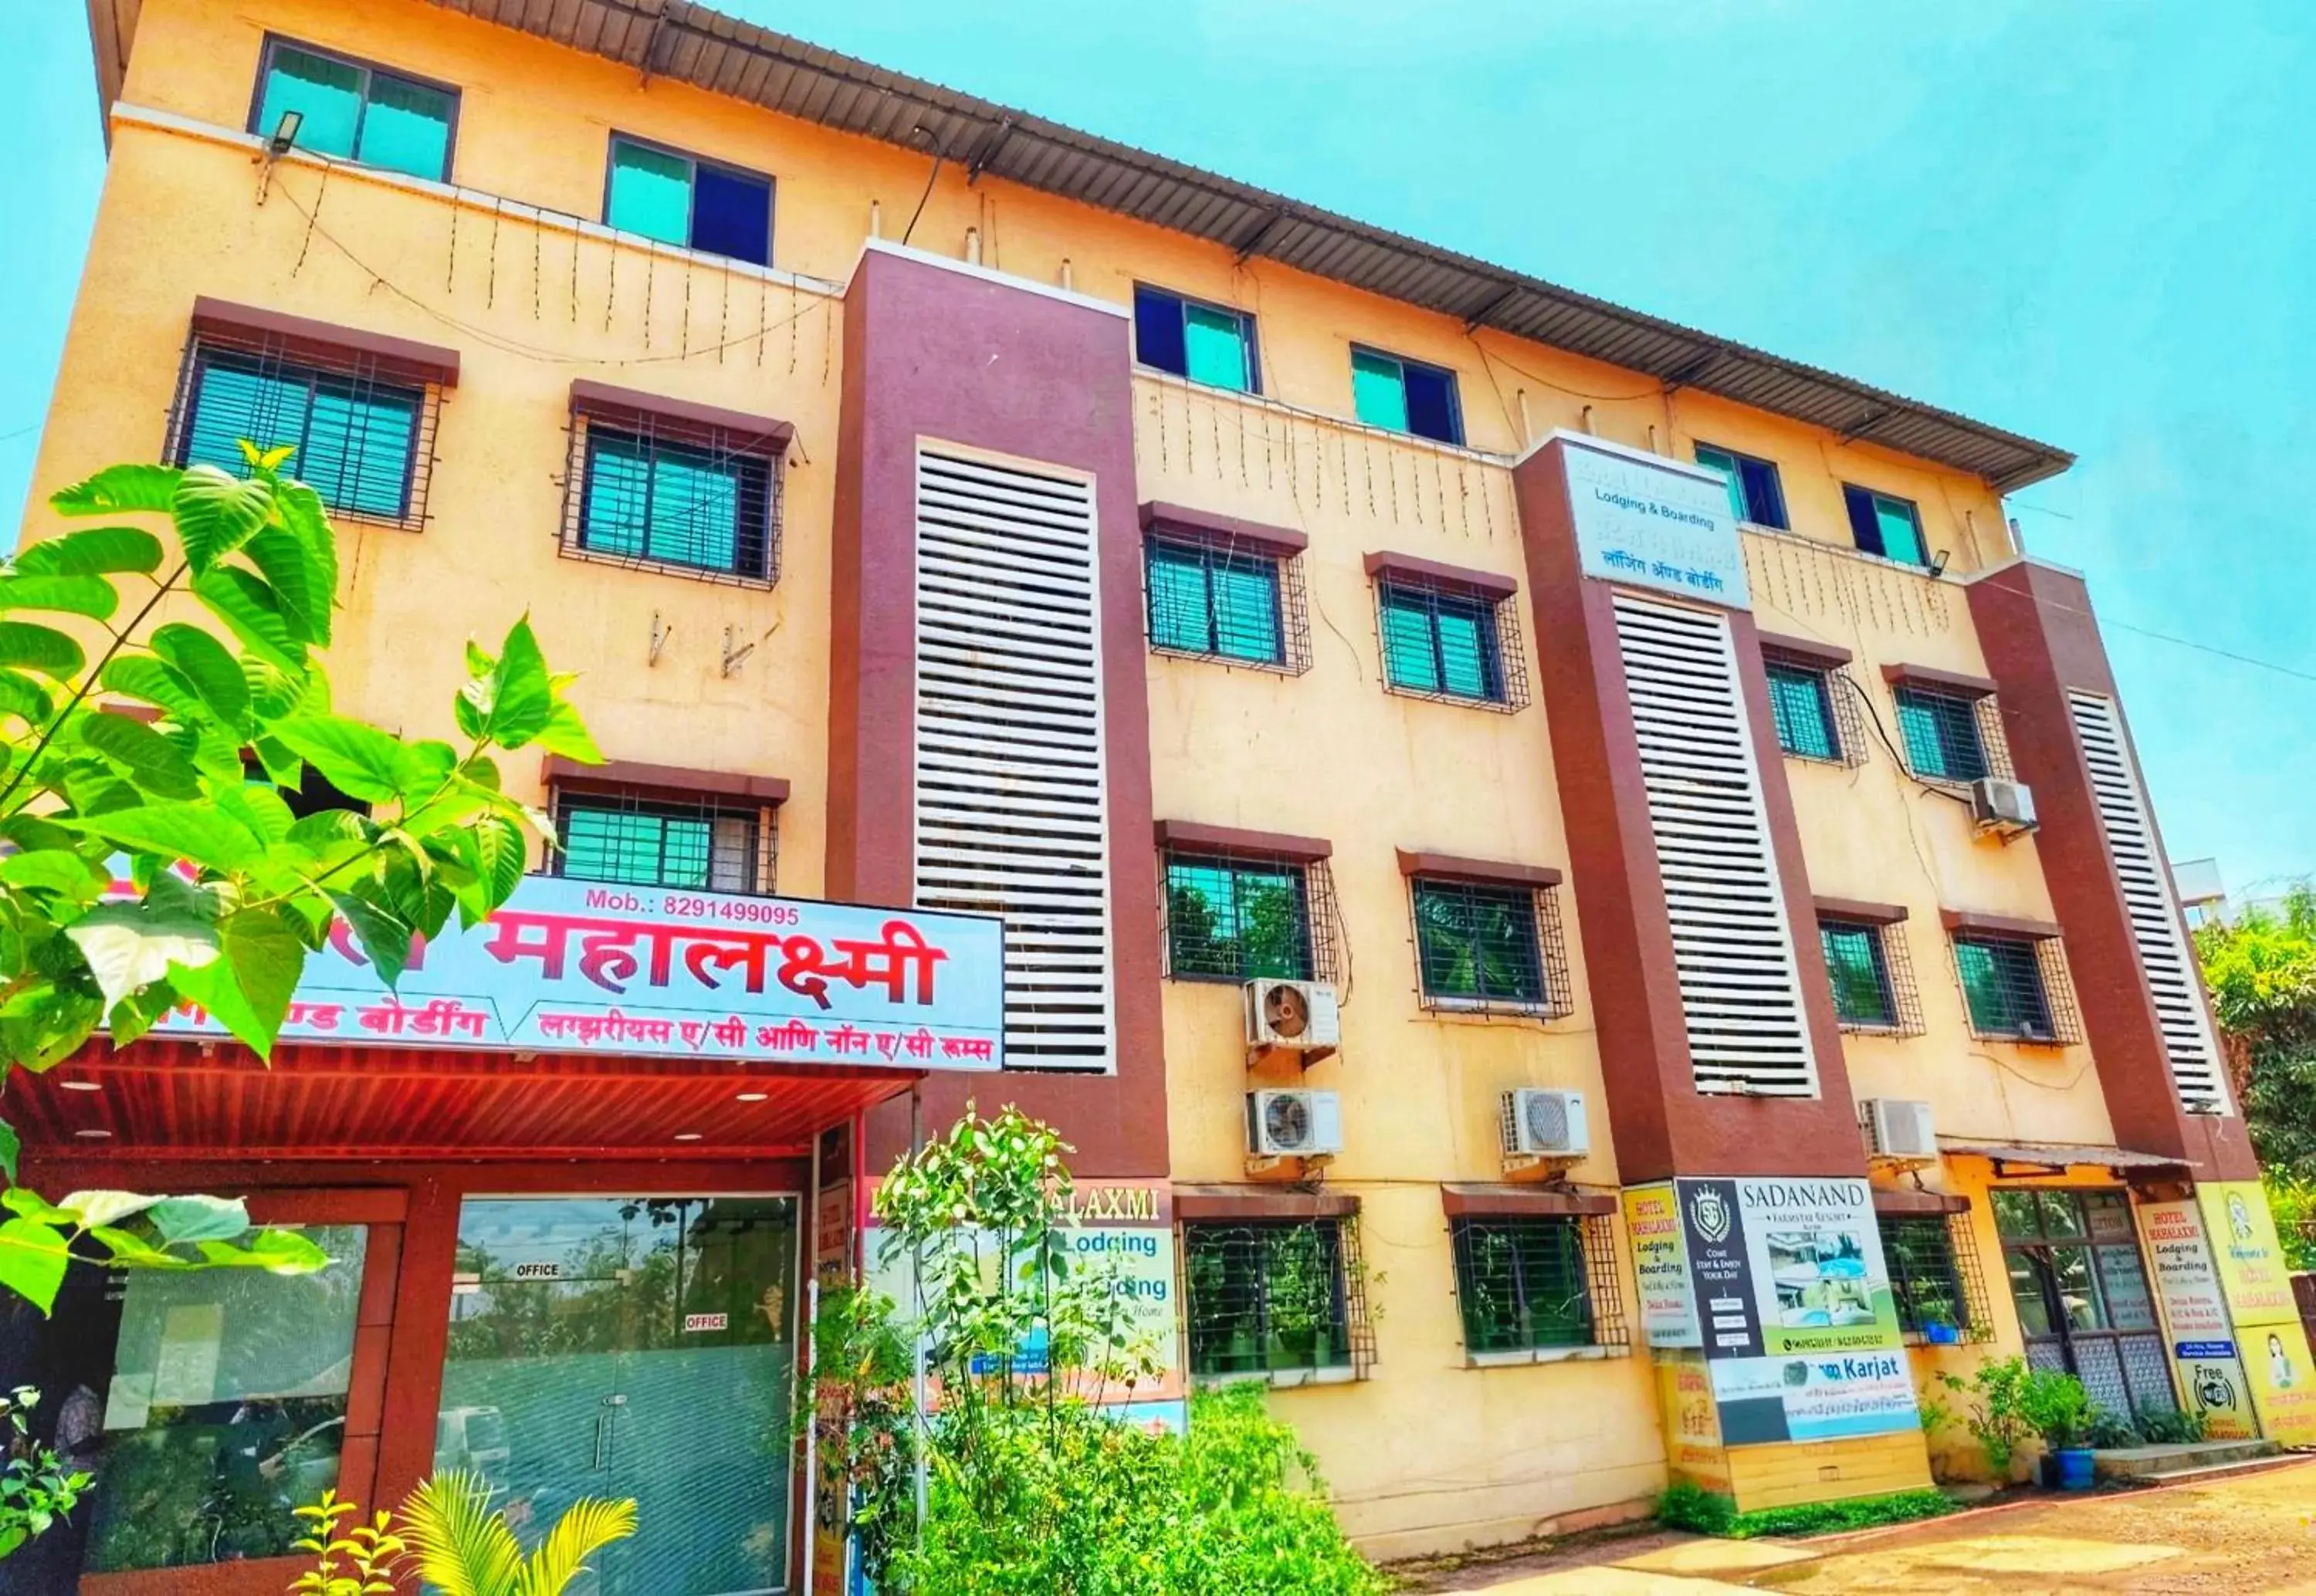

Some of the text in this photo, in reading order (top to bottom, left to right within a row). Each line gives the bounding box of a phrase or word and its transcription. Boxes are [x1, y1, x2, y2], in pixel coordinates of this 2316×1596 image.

[1595, 488, 1715, 531] Lodging & Boarding
[664, 895, 799, 925] 8291499095
[484, 911, 949, 1009] महालक्ष्मी
[757, 1020, 819, 1051] आणि
[824, 1024, 870, 1054] नॉन
[1744, 1184, 1864, 1208] SADANAND
[1066, 1232, 1157, 1257] oding
[1637, 1241, 1674, 1253] Lodging
[2156, 1243, 2198, 1254] Lodging
[516, 1264, 559, 1276] OFFICE
[1639, 1263, 1682, 1276] Boarding
[2159, 1261, 2207, 1273] Boarding
[686, 1316, 726, 1329] OFFICE
[1844, 1356, 1899, 1381] Karjat
[2194, 1364, 2223, 1380] Free
